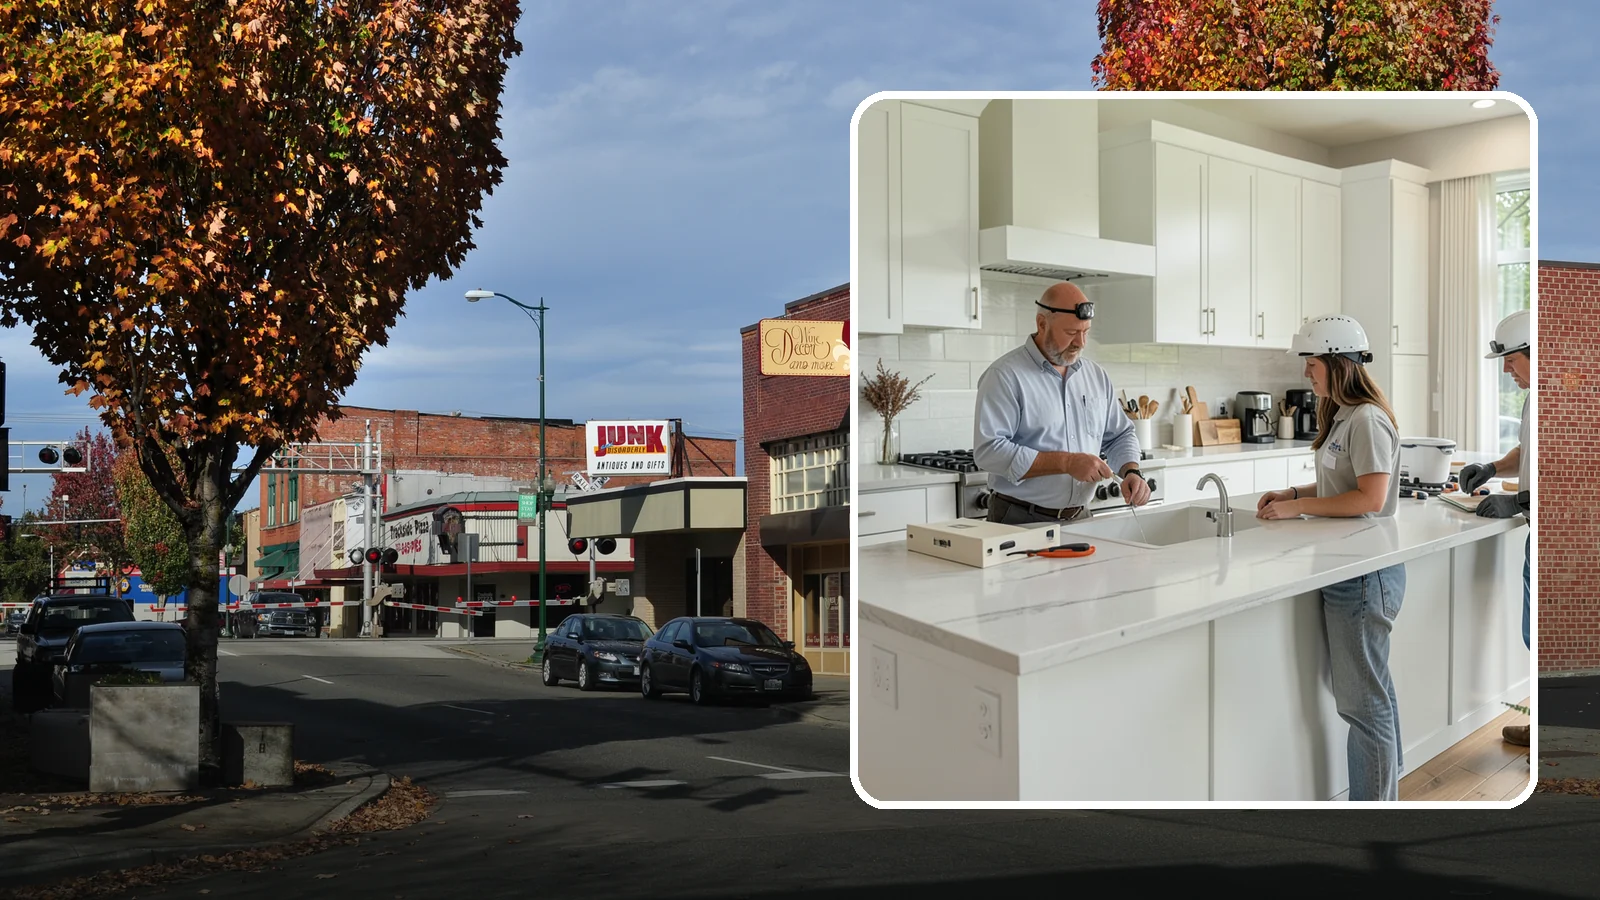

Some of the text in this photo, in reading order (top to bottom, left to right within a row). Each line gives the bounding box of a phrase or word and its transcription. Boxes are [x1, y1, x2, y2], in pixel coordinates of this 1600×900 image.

[595, 425, 665, 457] JUNK
[607, 446, 647, 454] DISORDERLY
[596, 460, 665, 470] ANTIQUES AND GIFTS
[390, 519, 429, 540] Trackside Pizza
